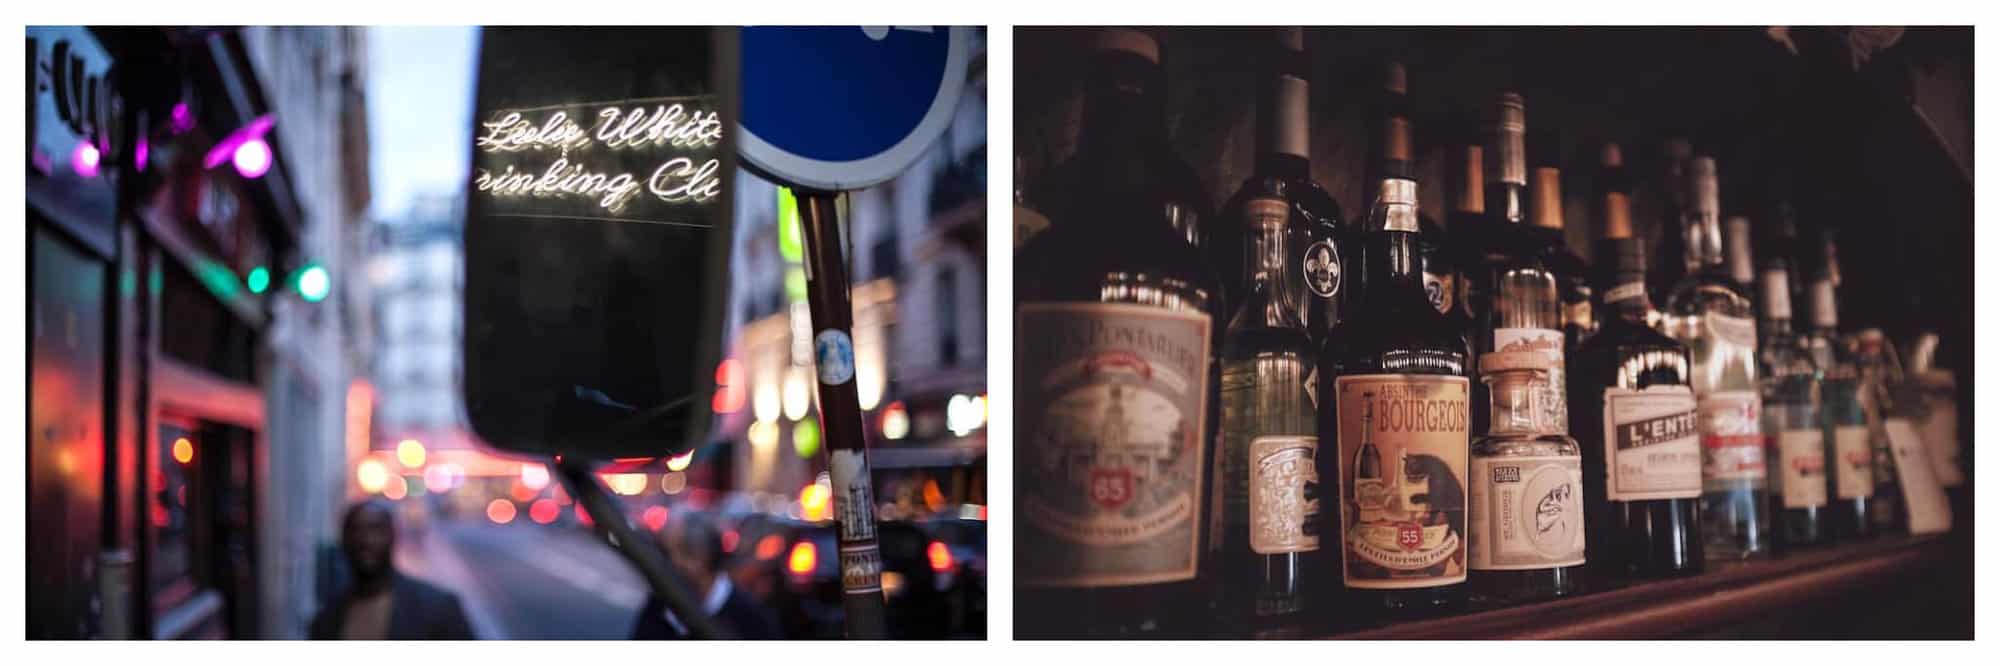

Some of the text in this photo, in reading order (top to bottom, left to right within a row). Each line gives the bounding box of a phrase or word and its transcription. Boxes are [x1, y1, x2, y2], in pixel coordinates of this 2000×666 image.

[1380, 398, 1465, 433] BOURGEOIS
[1094, 478, 1125, 501] 65
[1401, 530, 1419, 545] 55
